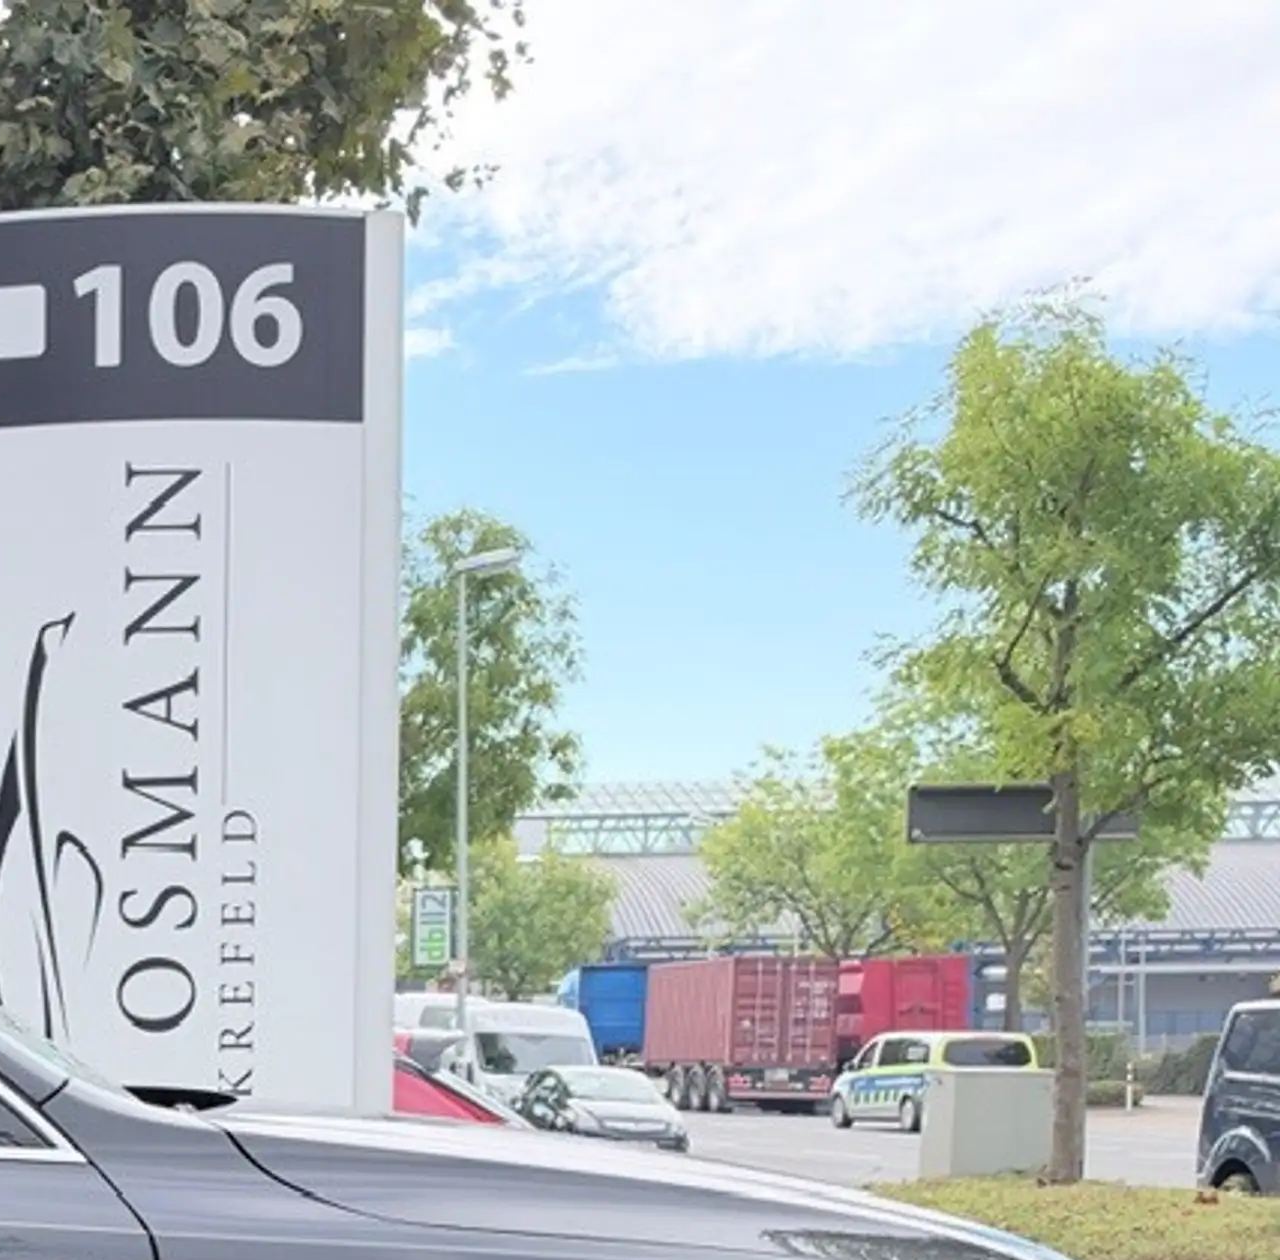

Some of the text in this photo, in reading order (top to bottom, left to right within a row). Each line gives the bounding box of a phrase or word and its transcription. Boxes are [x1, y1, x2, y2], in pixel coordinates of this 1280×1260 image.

[72, 261, 303, 368] 106
[116, 460, 203, 1033] OSMANN
[218, 809, 258, 1098] KREFELD
